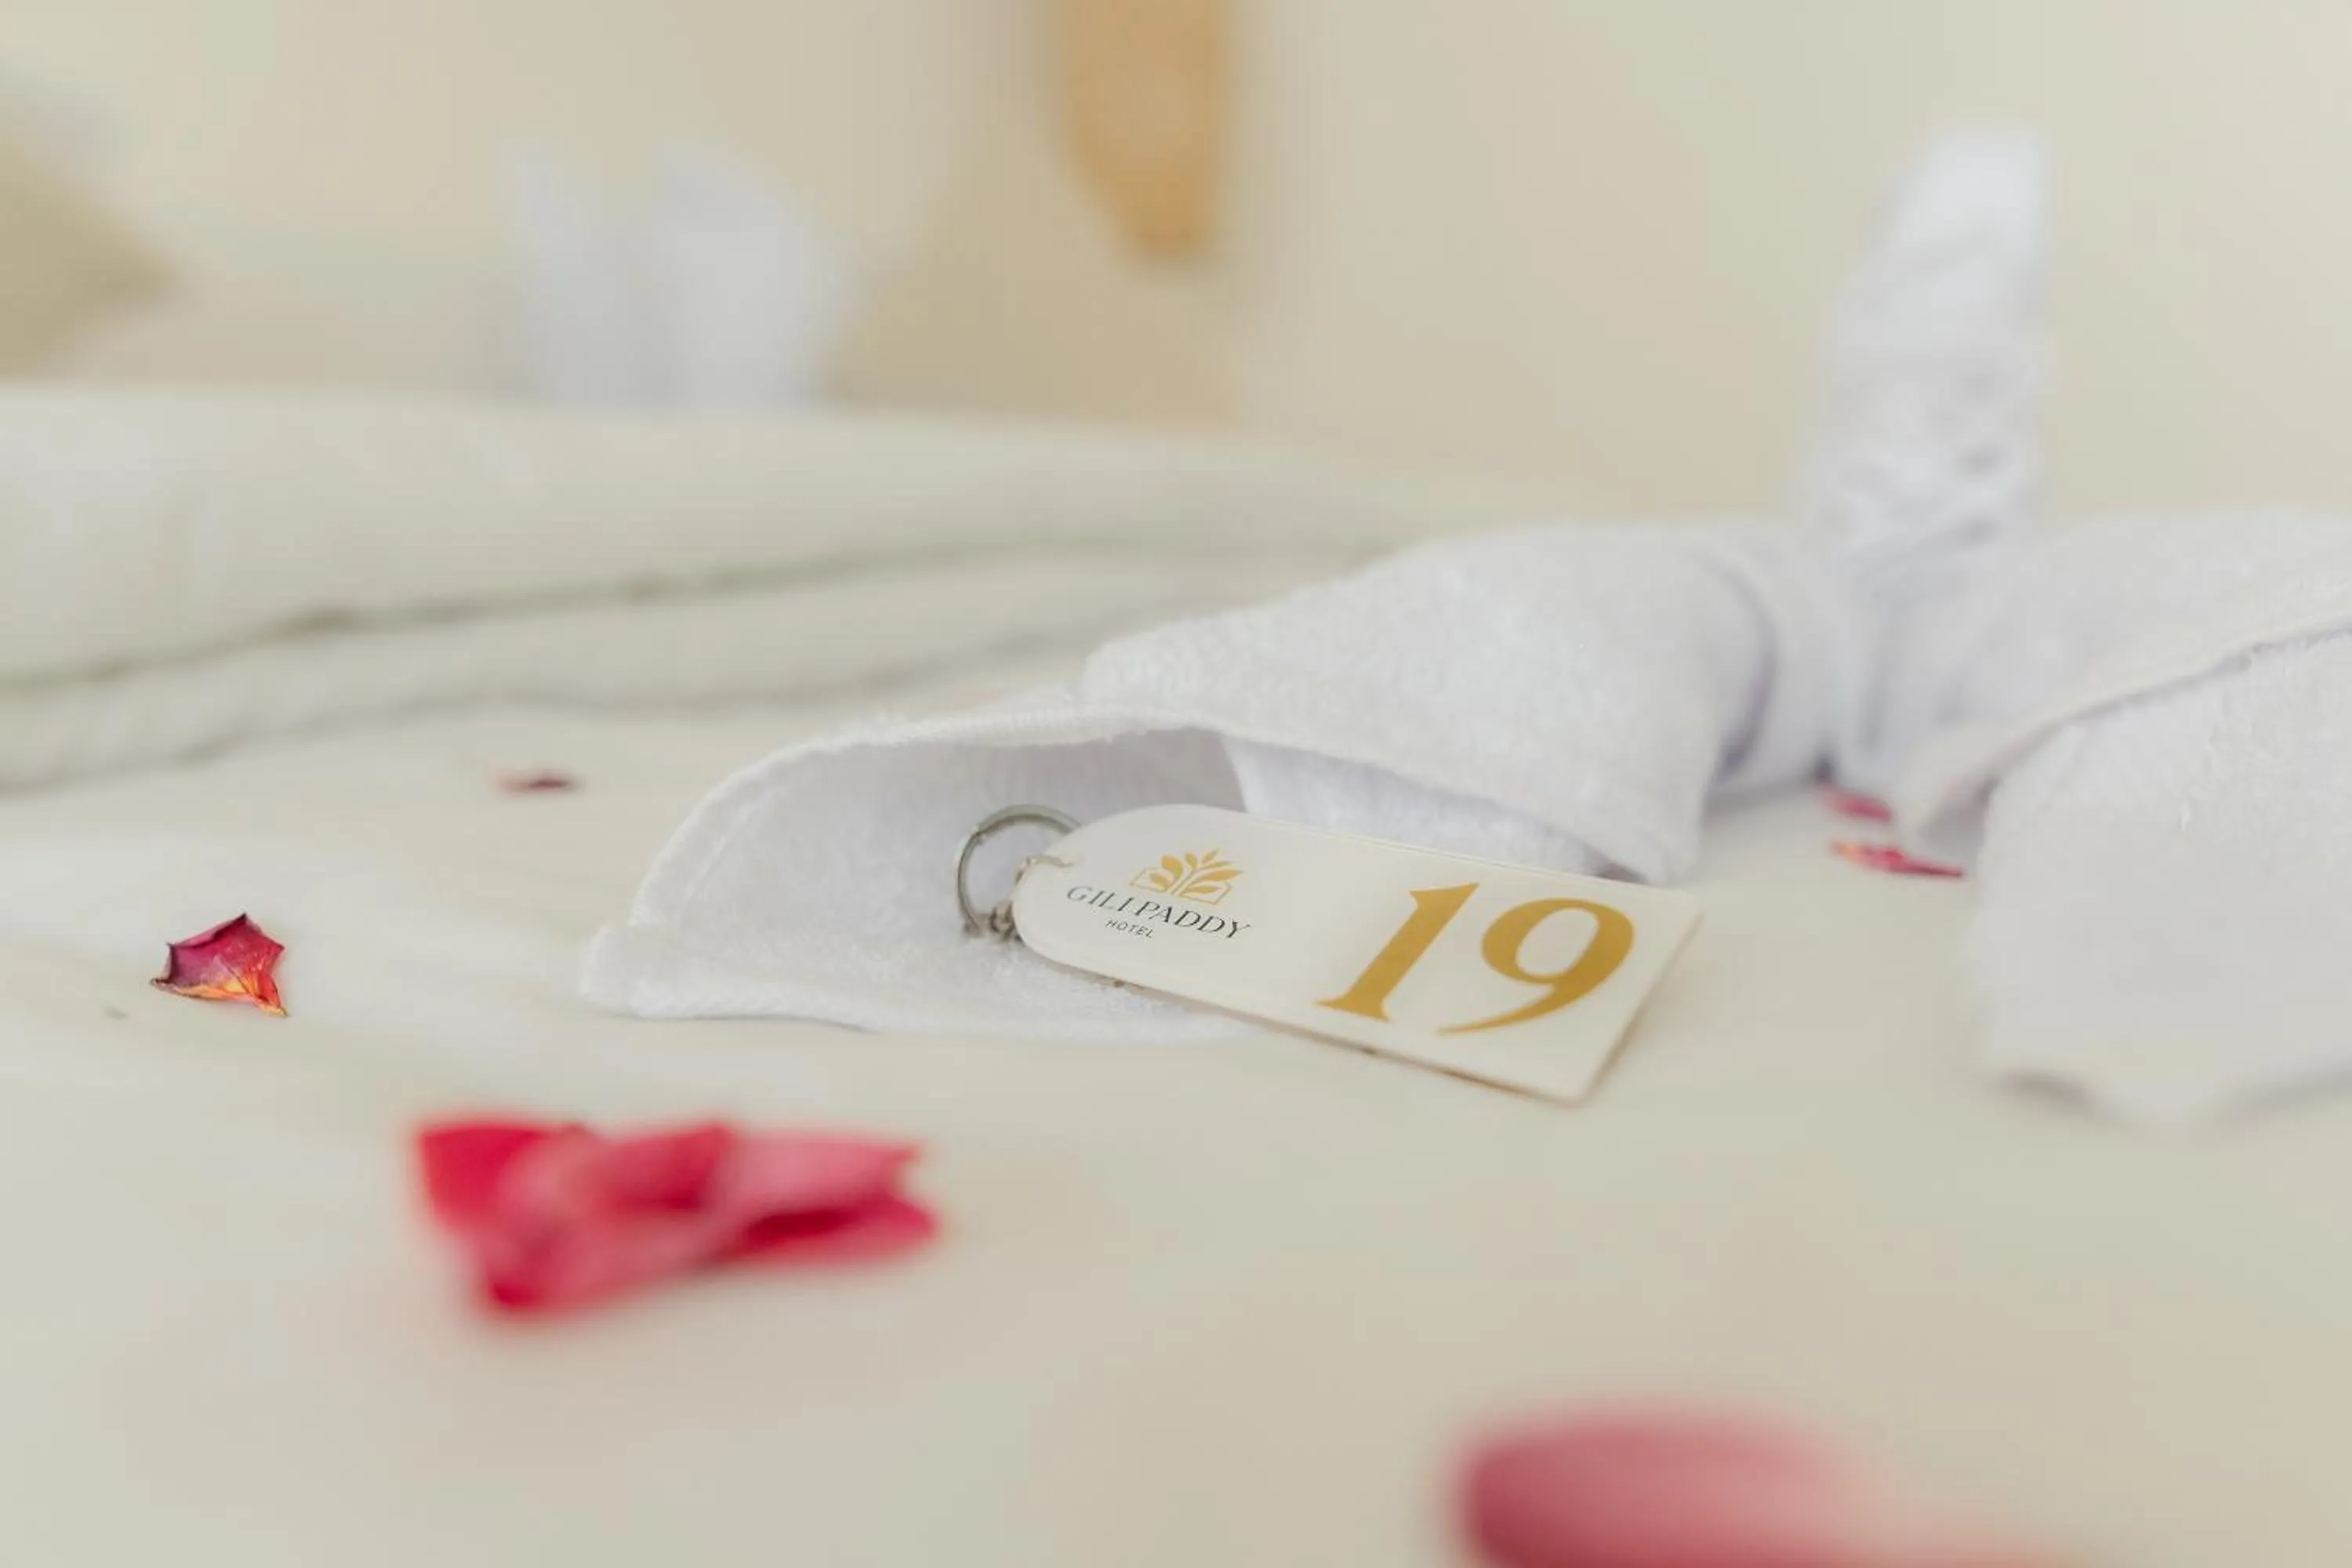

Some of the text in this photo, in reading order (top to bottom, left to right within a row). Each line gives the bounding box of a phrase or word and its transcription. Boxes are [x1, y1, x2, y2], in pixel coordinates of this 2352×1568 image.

[1066, 885, 1251, 939] GILI PADDY
[1105, 920, 1155, 939] HOTEL
[1315, 882, 1635, 1035] 19
